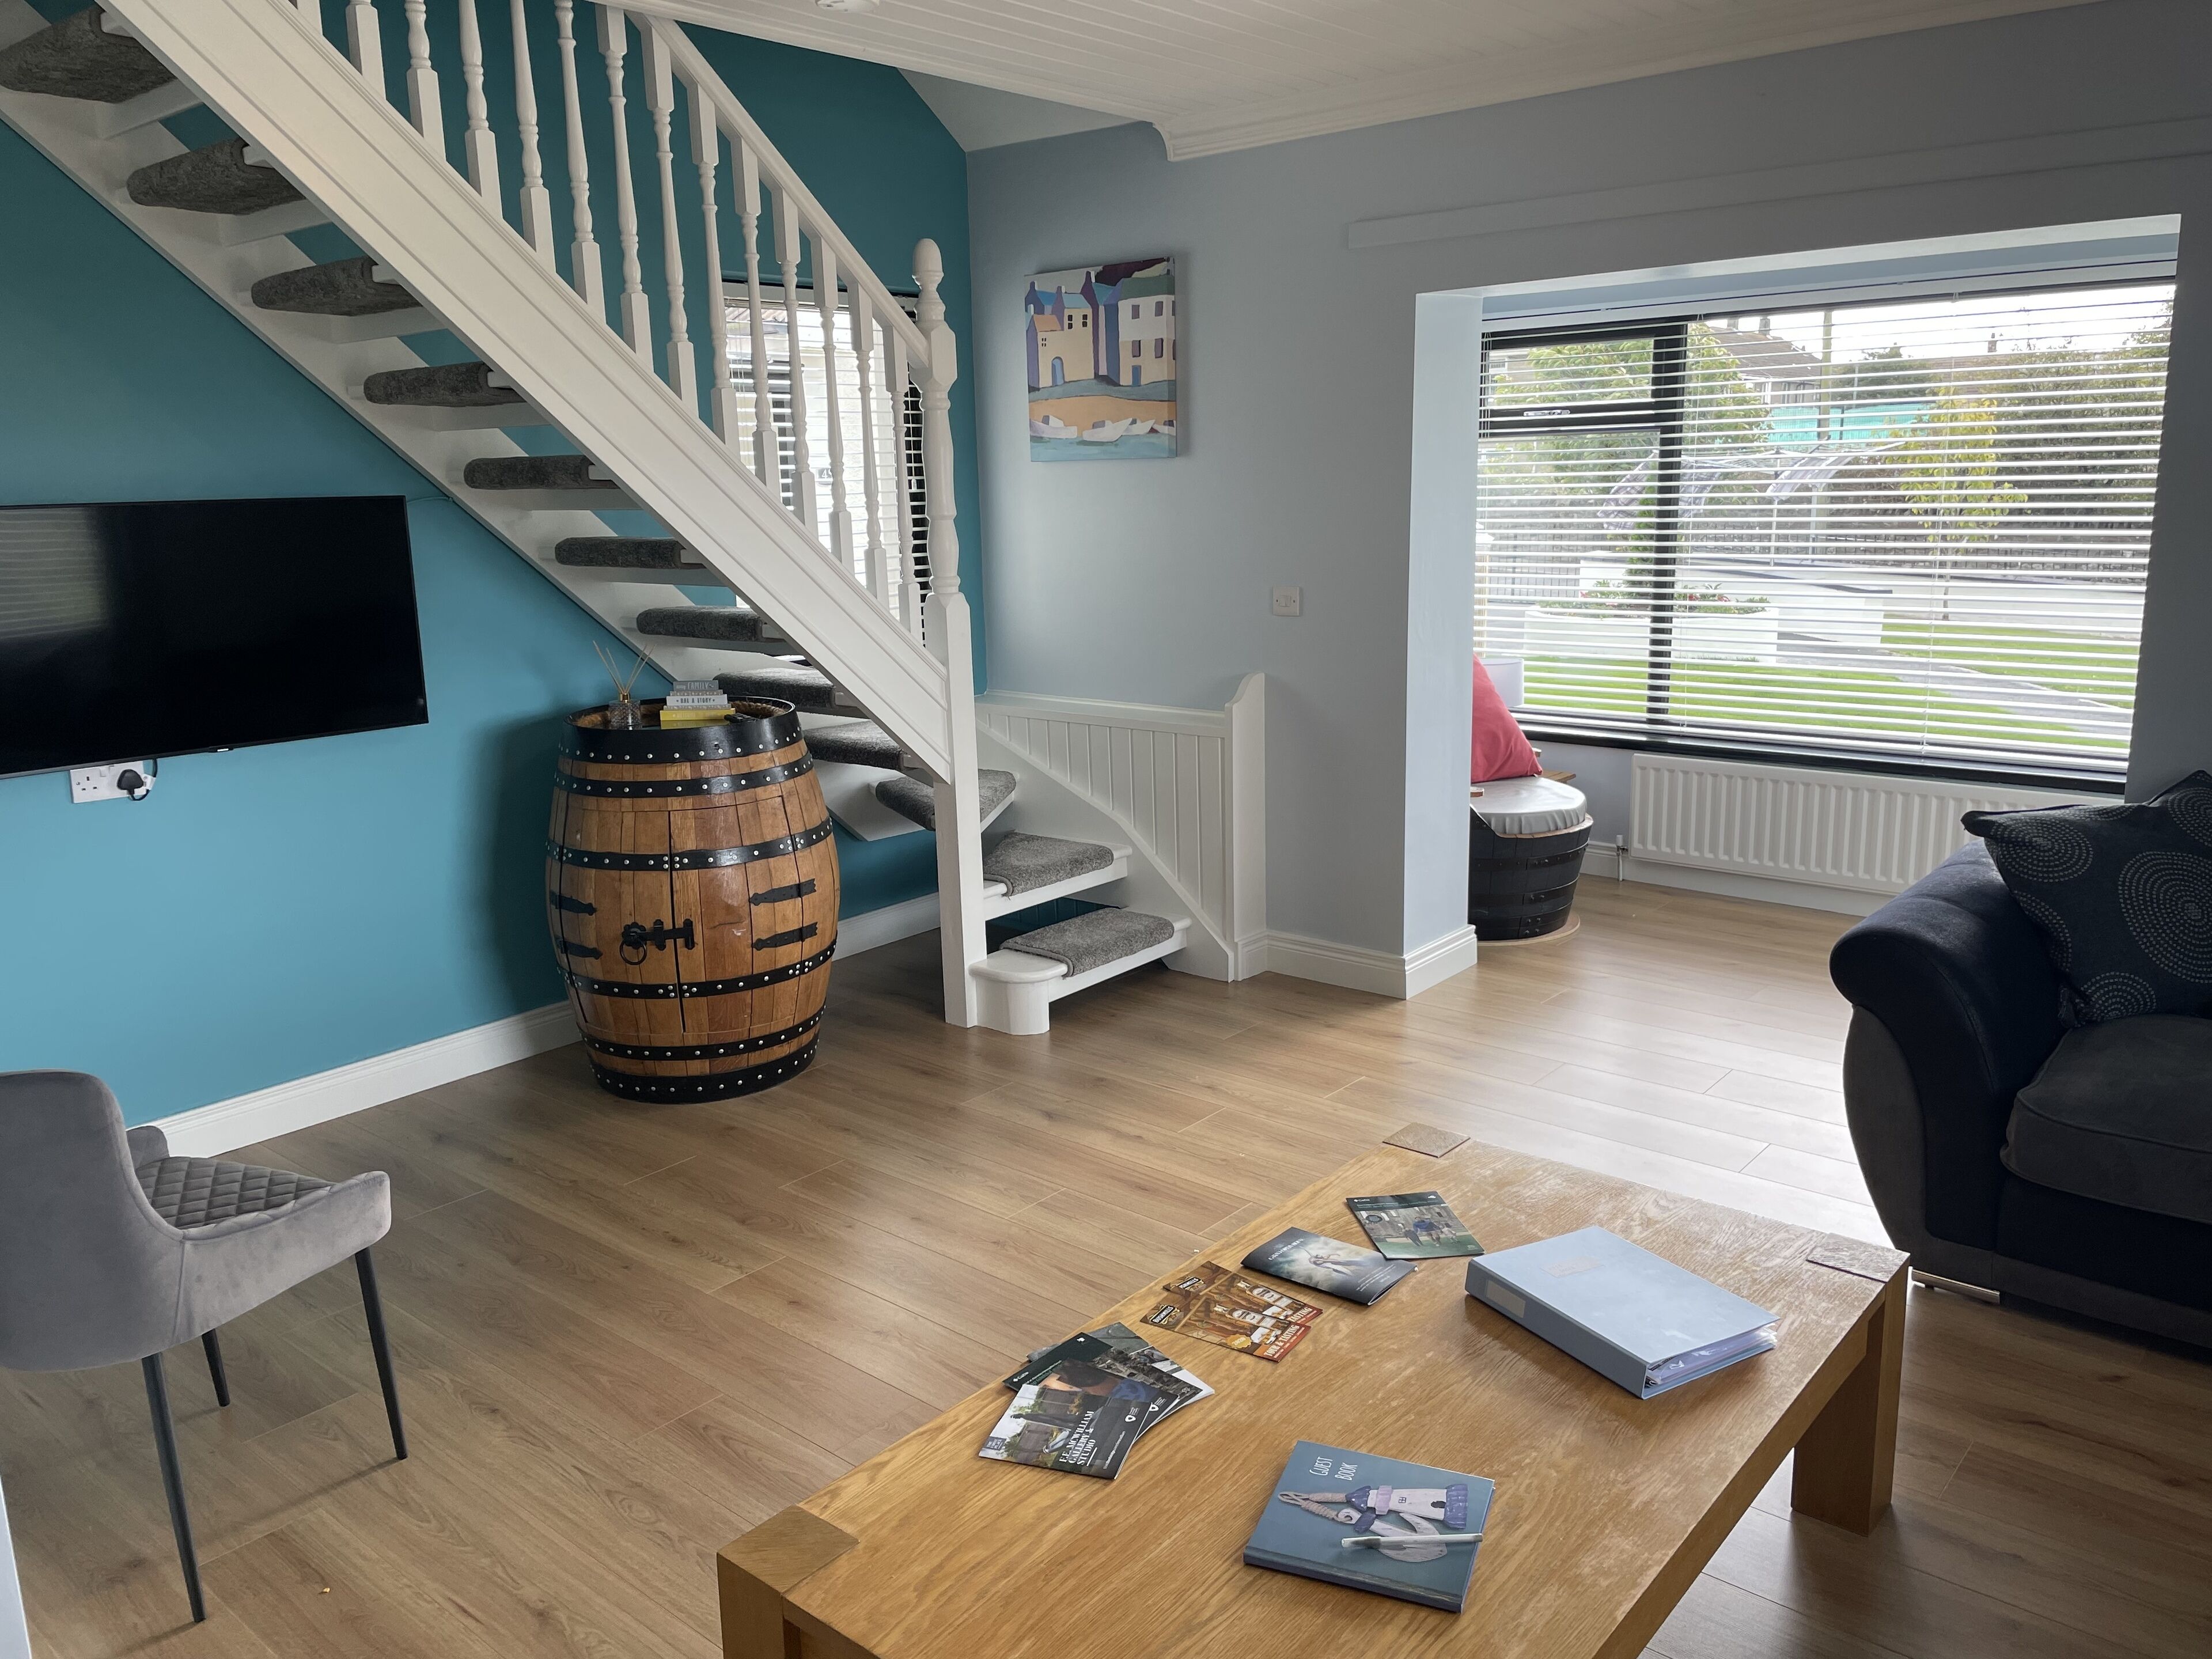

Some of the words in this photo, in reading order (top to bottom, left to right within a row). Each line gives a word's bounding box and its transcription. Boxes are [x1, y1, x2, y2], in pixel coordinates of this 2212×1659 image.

[687, 681, 709, 690] FAMILY
[1152, 1306, 1174, 1323] BUSHMILLS
[1288, 1306, 1313, 1322] TASTING
[1263, 1344, 1280, 1357] TOUR
[1279, 1325, 1300, 1342] TASTING
[1068, 1433, 1090, 1464] GALLERY
[1077, 1439, 1096, 1465] STUDIO
[1309, 1456, 1333, 1476] GUEST
[1334, 1462, 1358, 1480] BOOK
